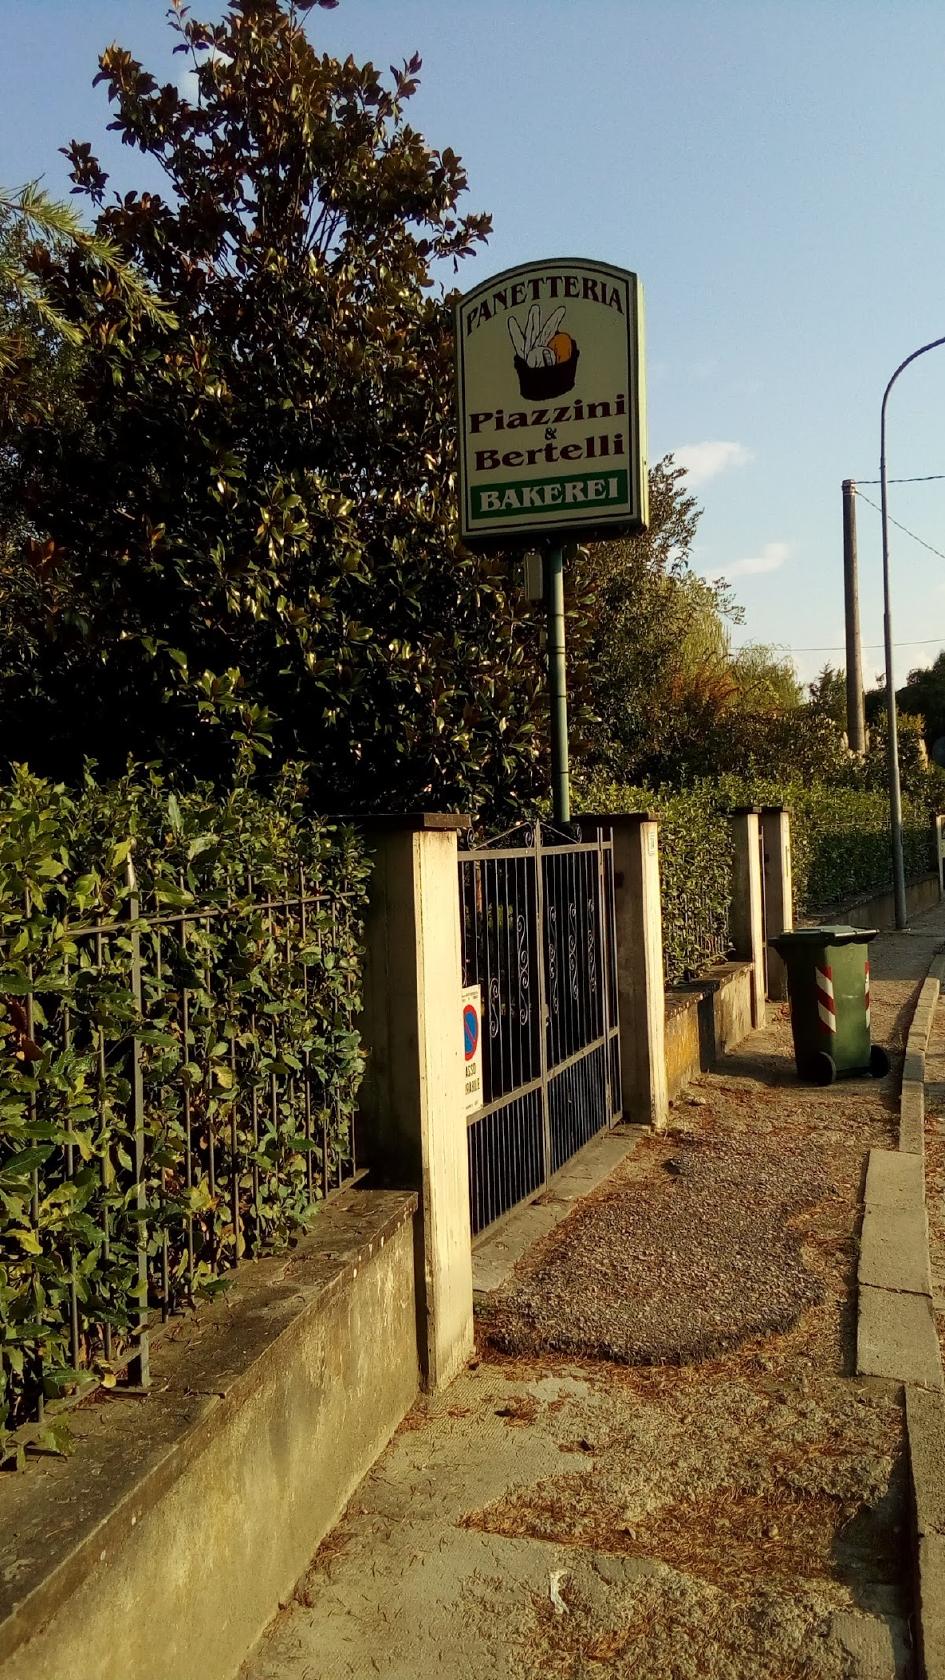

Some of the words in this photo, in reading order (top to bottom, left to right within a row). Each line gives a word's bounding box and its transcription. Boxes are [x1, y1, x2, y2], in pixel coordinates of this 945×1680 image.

[466, 275, 625, 337] PANETTERIA
[469, 394, 627, 434] Piazzini
[475, 433, 625, 471] Bertelli
[544, 427, 557, 441] &
[479, 477, 619, 512] BAKEREI
